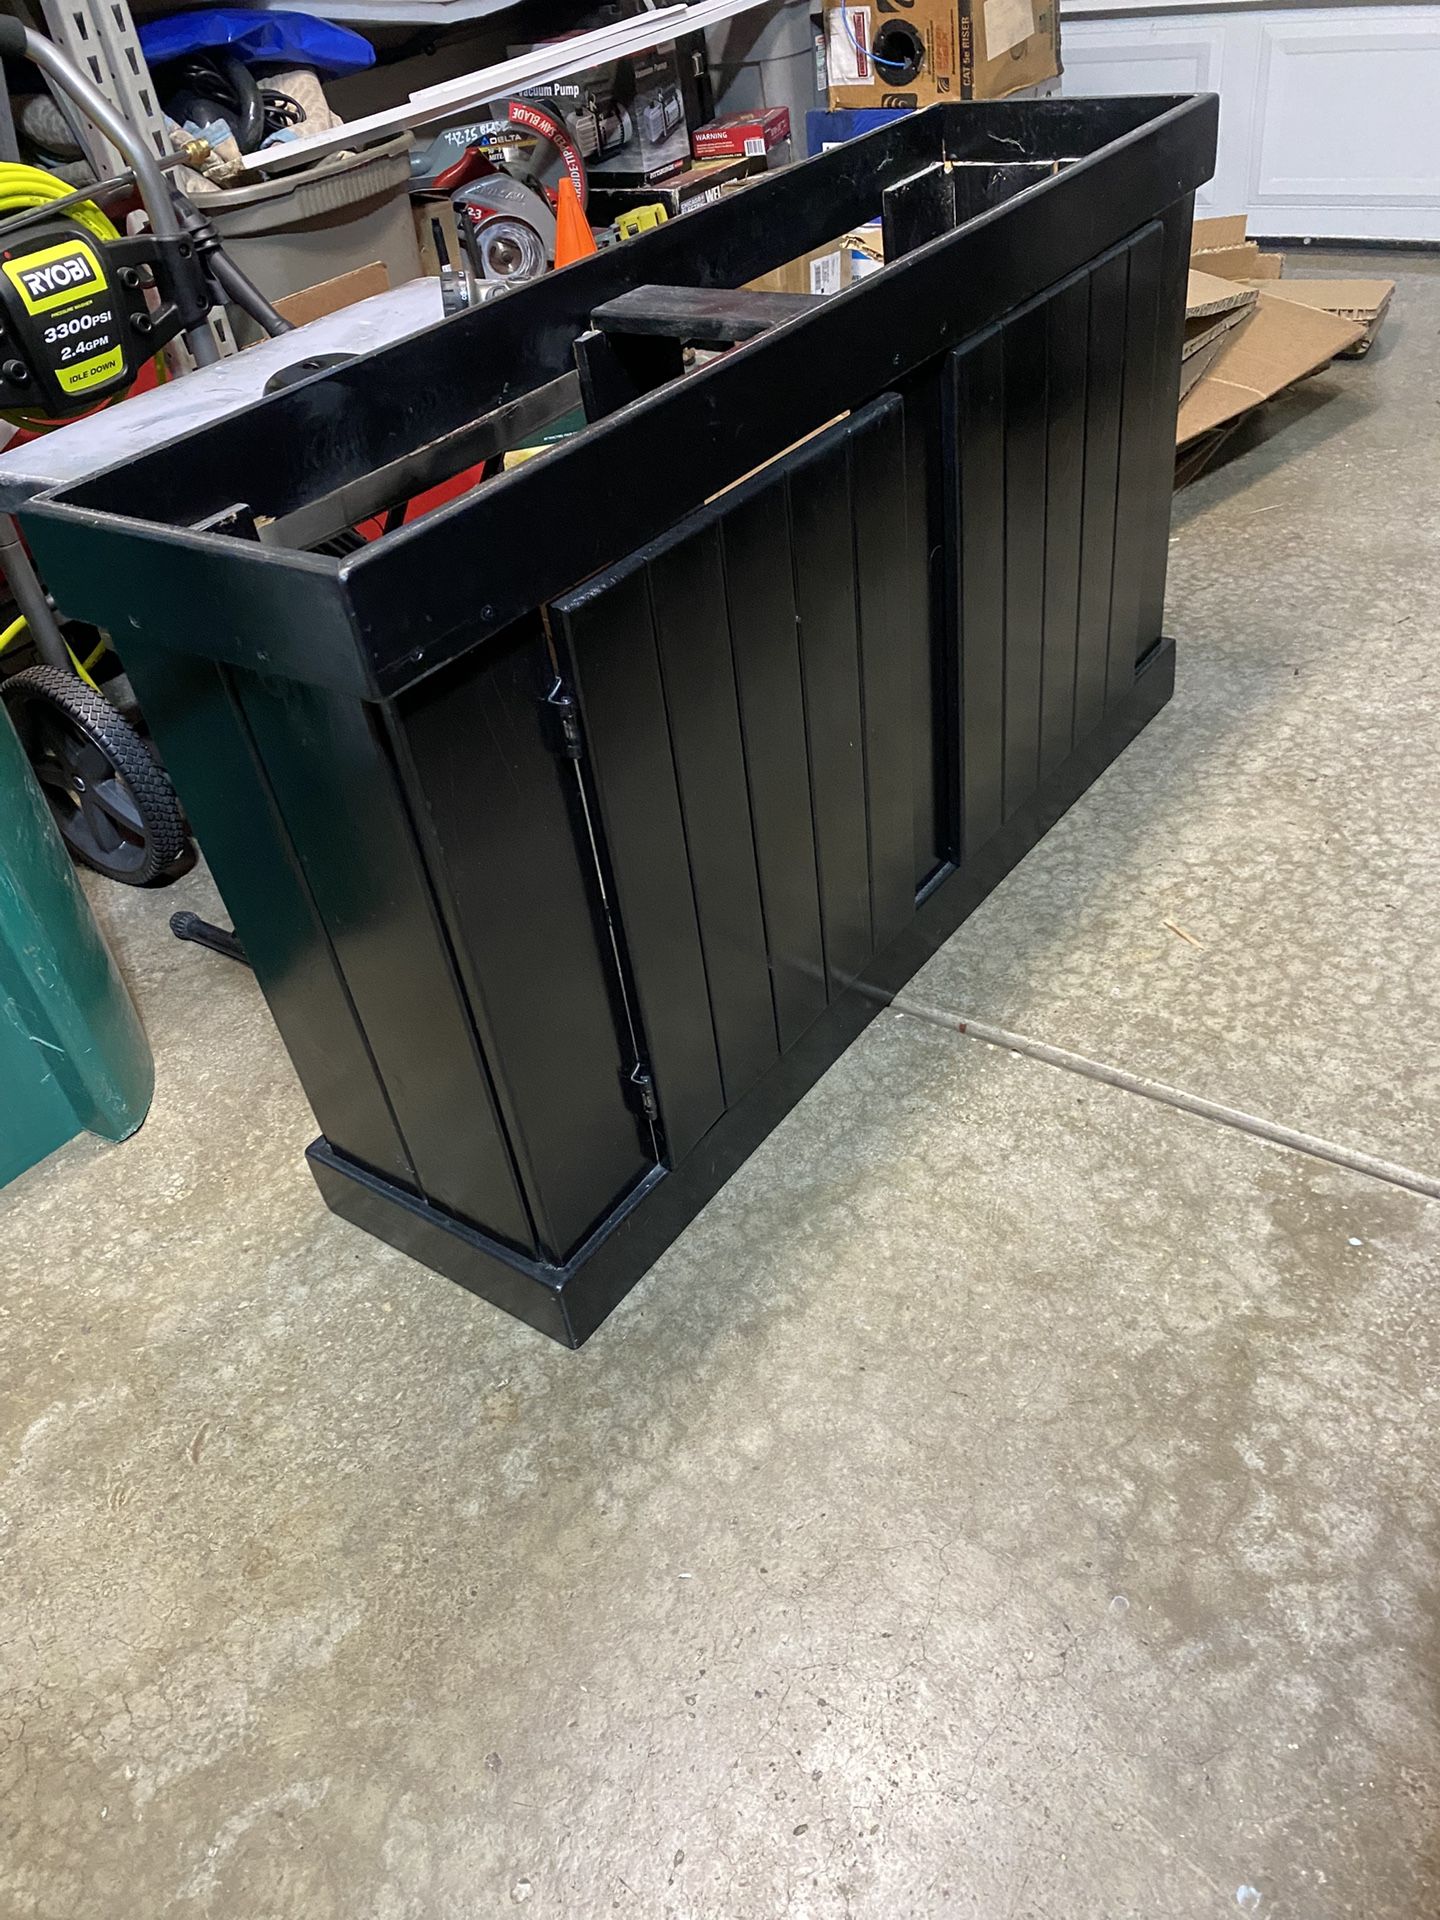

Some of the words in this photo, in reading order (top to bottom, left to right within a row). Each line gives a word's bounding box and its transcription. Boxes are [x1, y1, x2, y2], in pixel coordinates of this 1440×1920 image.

[962, 16, 970, 48] RISER
[962, 66, 971, 86] CAT
[553, 83, 579, 98] Pump
[511, 107, 541, 126] BLADE
[489, 134, 521, 145] DELTA
[695, 131, 728, 141] WARNING
[22, 257, 91, 295] RYOBI
[69, 371, 88, 384] IDLE
[90, 361, 116, 375] DOWN
